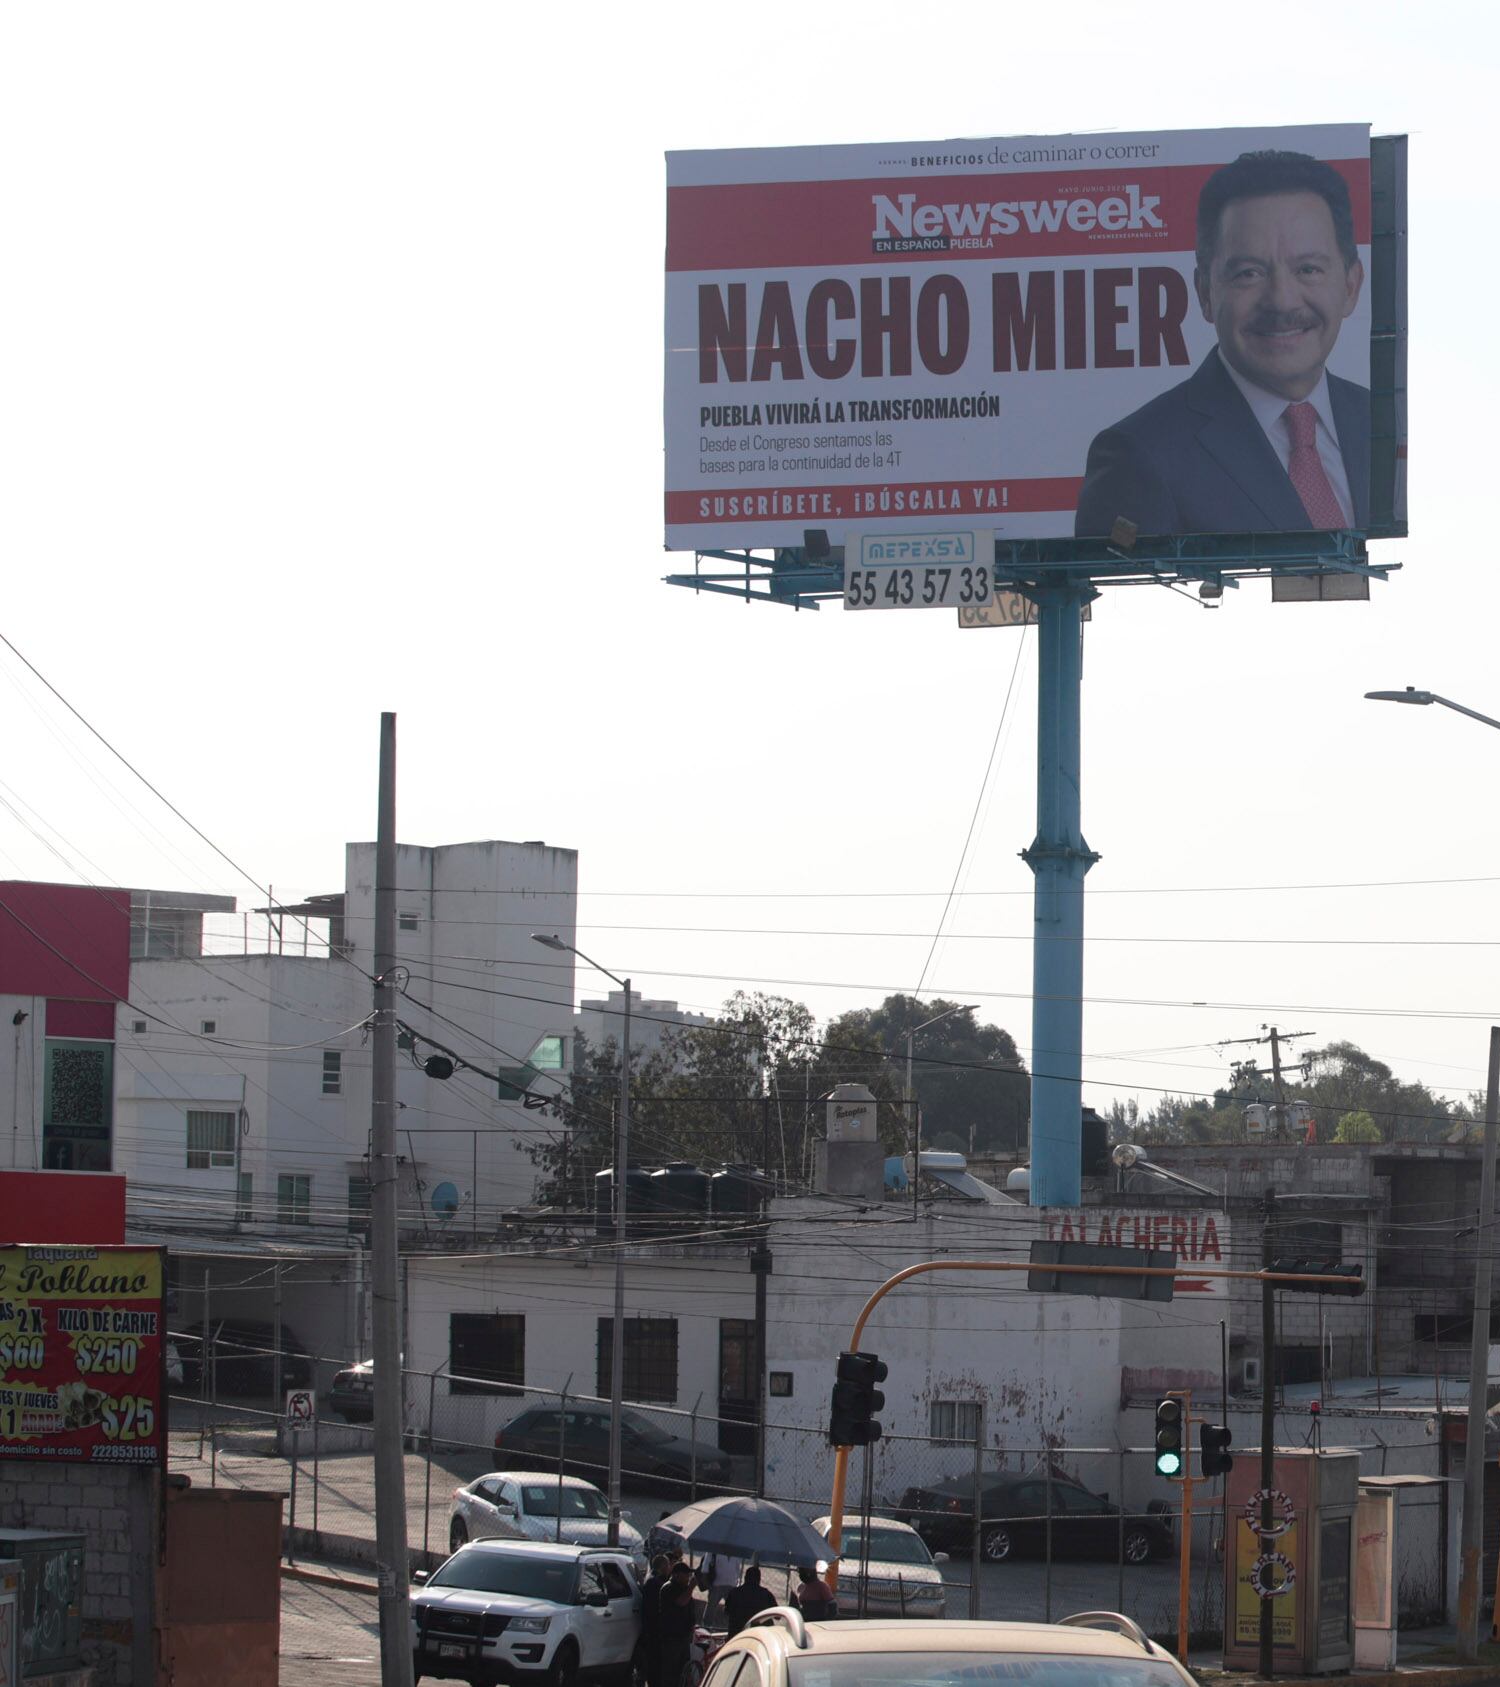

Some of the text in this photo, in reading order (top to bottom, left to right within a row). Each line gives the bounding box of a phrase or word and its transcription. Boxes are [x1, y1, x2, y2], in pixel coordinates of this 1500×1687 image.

[911, 154, 984, 167] BENEFICIOS
[987, 146, 1009, 165] de
[1012, 147, 1087, 163] caminar
[1090, 148, 1101, 159] o
[1105, 144, 1160, 159] correr
[872, 184, 1163, 238] Newsweek
[876, 237, 994, 251] EN ESPAÑOL PUEBLA
[699, 263, 1190, 384] NACHO MIER
[700, 391, 1000, 427] PUEBLA VIVIRÁ LA TRANSFORMACIÓN
[700, 431, 892, 453] Desde el Congreso sentamos las
[700, 451, 902, 475] bases para la continuidad de la 4T
[700, 486, 1009, 517] SUSCRÍBETE, ¡BÚSCALA YA!
[868, 538, 966, 559] MEPEXSA
[848, 567, 989, 606] 55 43 57 33
[17, 1264, 149, 1294] Poblano
[0, 1302, 43, 1333] AS 2 X
[58, 1309, 157, 1335] KILO DE CARNE
[0, 1333, 45, 1370] $60
[75, 1334, 138, 1376] $250
[16, 1392, 23, 1406] Y
[24, 1393, 59, 1410] JUEVES
[99, 1394, 155, 1441] $25
[42, 1445, 57, 1455] sin
[57, 1446, 83, 1456] costo
[1250, 1552, 1297, 1595] TALACHAS
